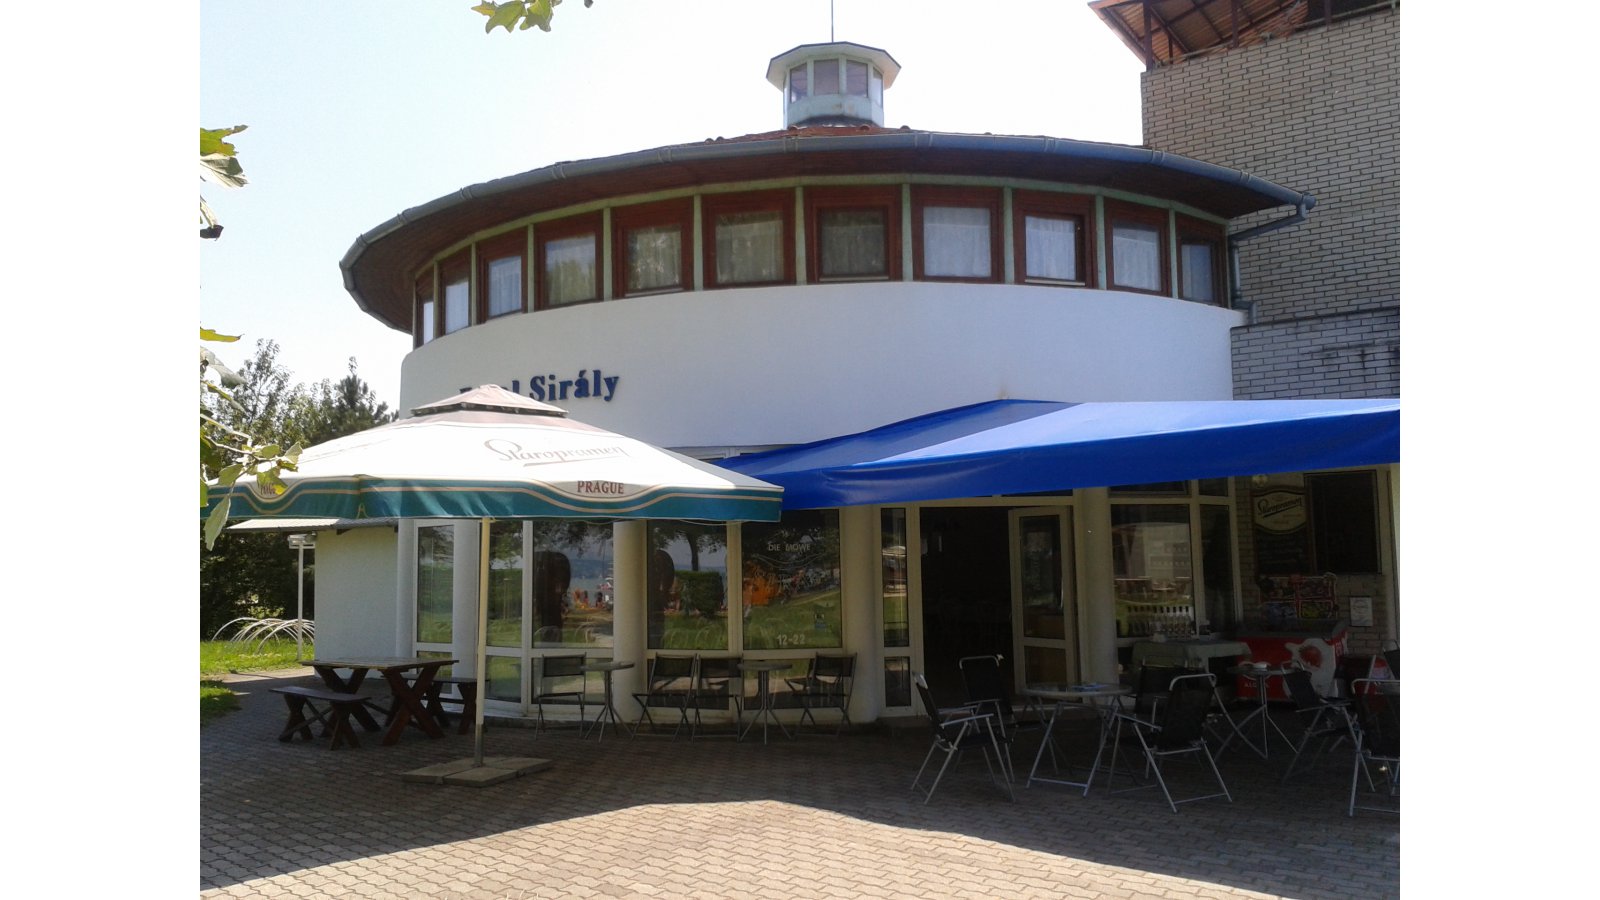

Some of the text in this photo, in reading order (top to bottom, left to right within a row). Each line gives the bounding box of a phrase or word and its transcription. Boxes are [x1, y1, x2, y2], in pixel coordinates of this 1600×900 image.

[529, 370, 620, 402] Sirály
[484, 438, 630, 464] Staropramen
[577, 480, 625, 495] PRAGUE
[768, 543, 781, 551] DIE
[776, 633, 806, 646] 12-22
